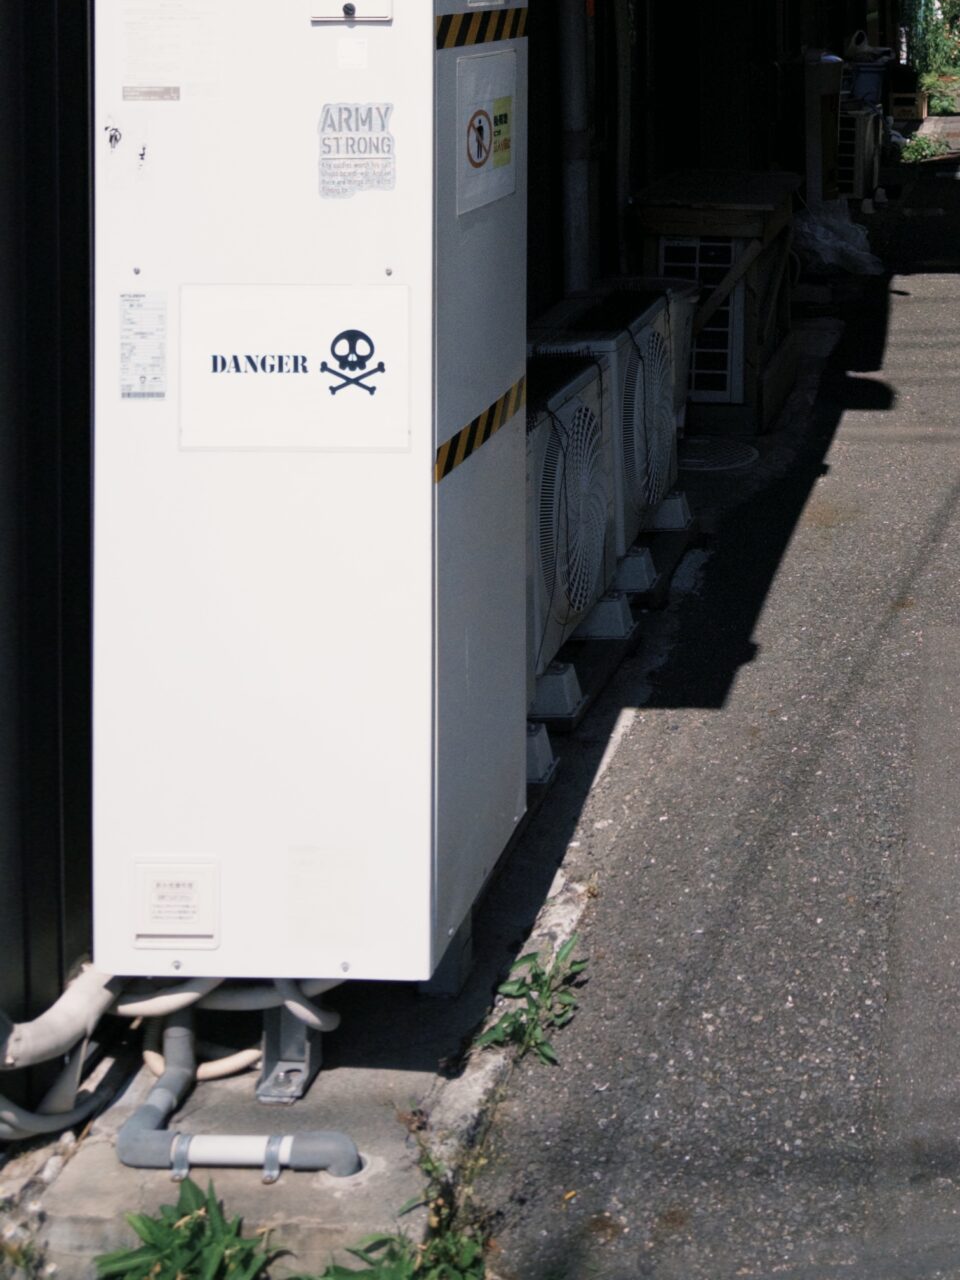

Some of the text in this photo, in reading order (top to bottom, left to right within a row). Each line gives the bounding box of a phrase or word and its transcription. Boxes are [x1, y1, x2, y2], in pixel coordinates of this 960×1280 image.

[321, 106, 390, 132] ARMY
[321, 136, 392, 154] STRONG
[210, 355, 309, 373] DANGER
